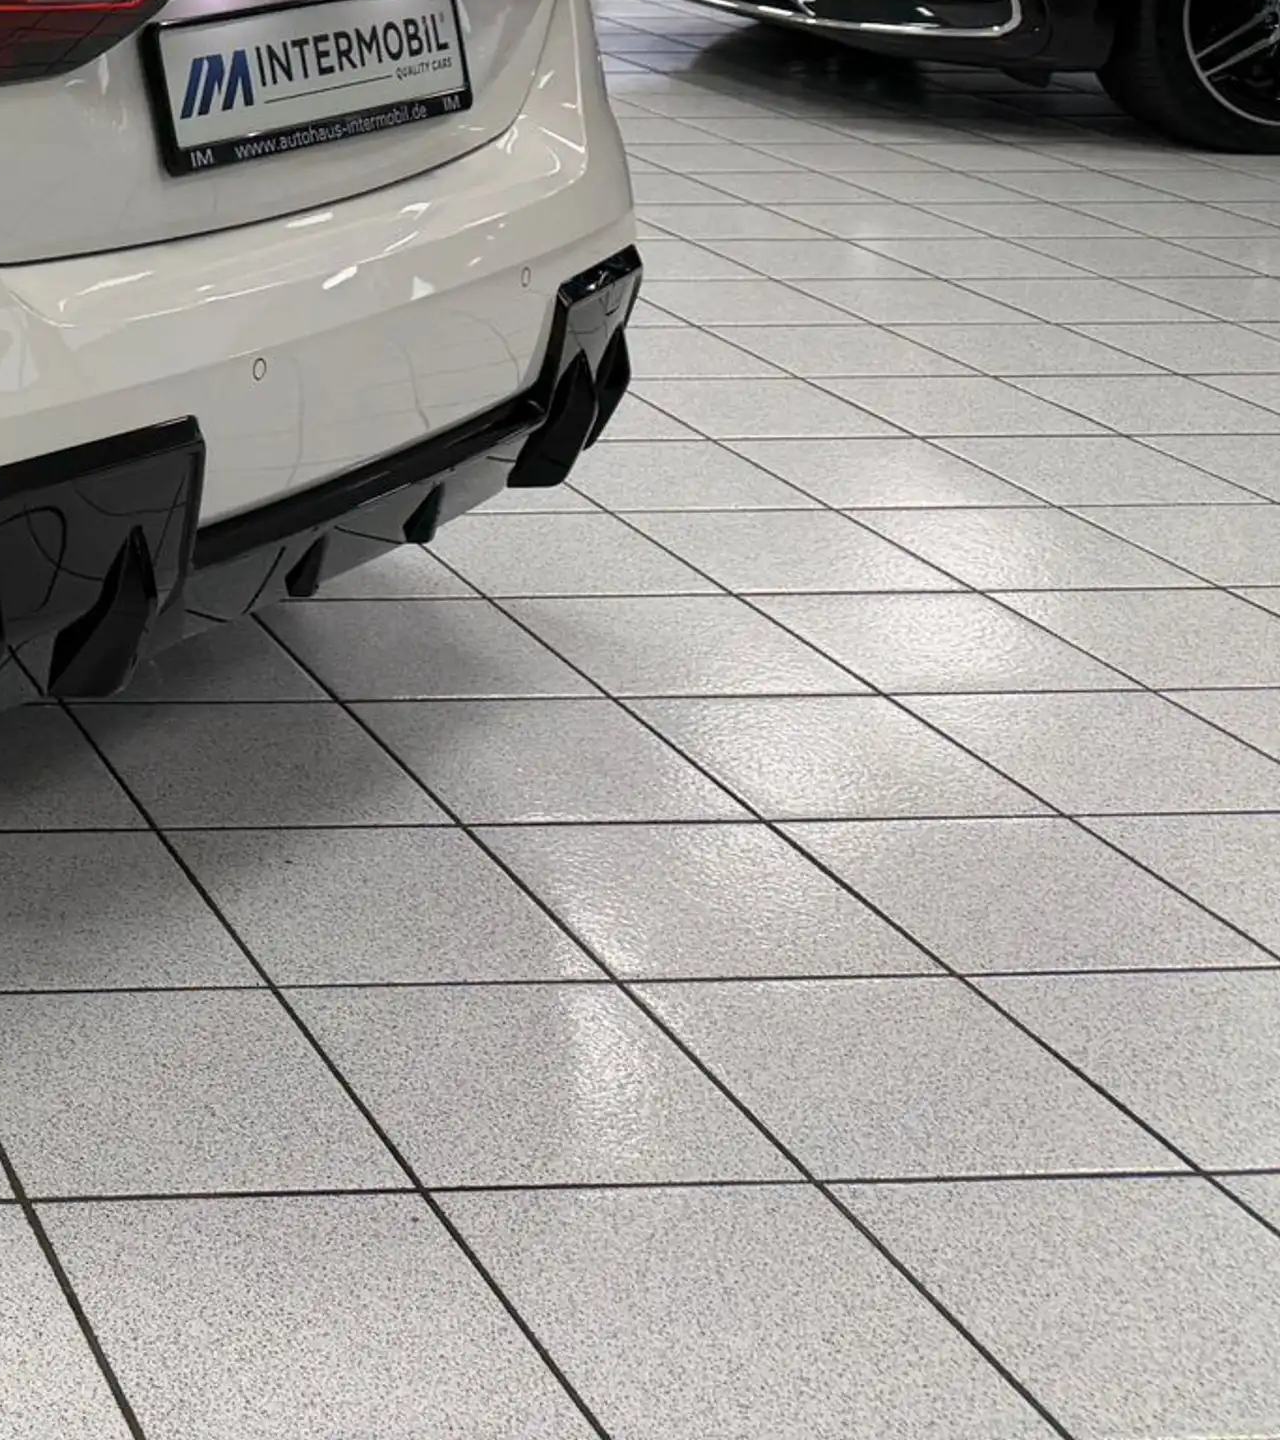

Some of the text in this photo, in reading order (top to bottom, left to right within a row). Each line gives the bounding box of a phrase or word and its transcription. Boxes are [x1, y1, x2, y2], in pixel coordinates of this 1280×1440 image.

[396, 60, 430, 80] QUALITY
[190, 95, 461, 168] IM www.autohaus-intermobil.de IM
